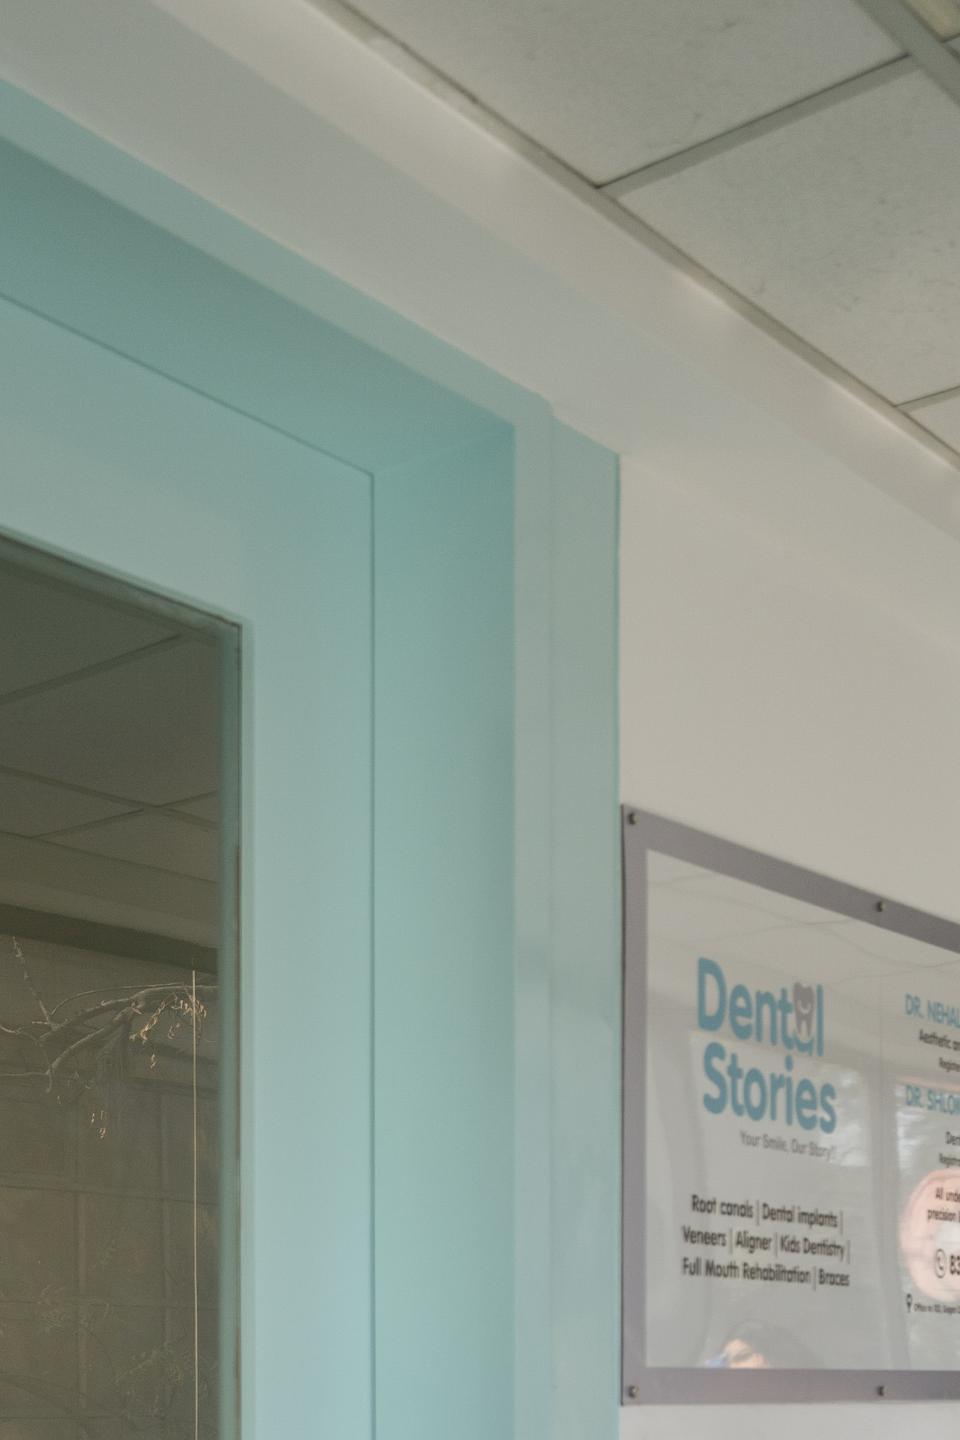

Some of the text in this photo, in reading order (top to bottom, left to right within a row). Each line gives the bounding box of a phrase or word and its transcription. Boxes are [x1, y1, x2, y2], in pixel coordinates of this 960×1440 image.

[697, 956, 824, 1057] Dental
[703, 1042, 837, 1134] Stories
[740, 1130, 761, 1147] Your
[792, 1138, 808, 1154] Our
[692, 1195, 838, 1228] Root canals Dental implants
[683, 1227, 844, 1262] Veneers Aligner Kids Dentistry
[683, 1257, 850, 1287] Full Mouth Rehabilitation Braces
